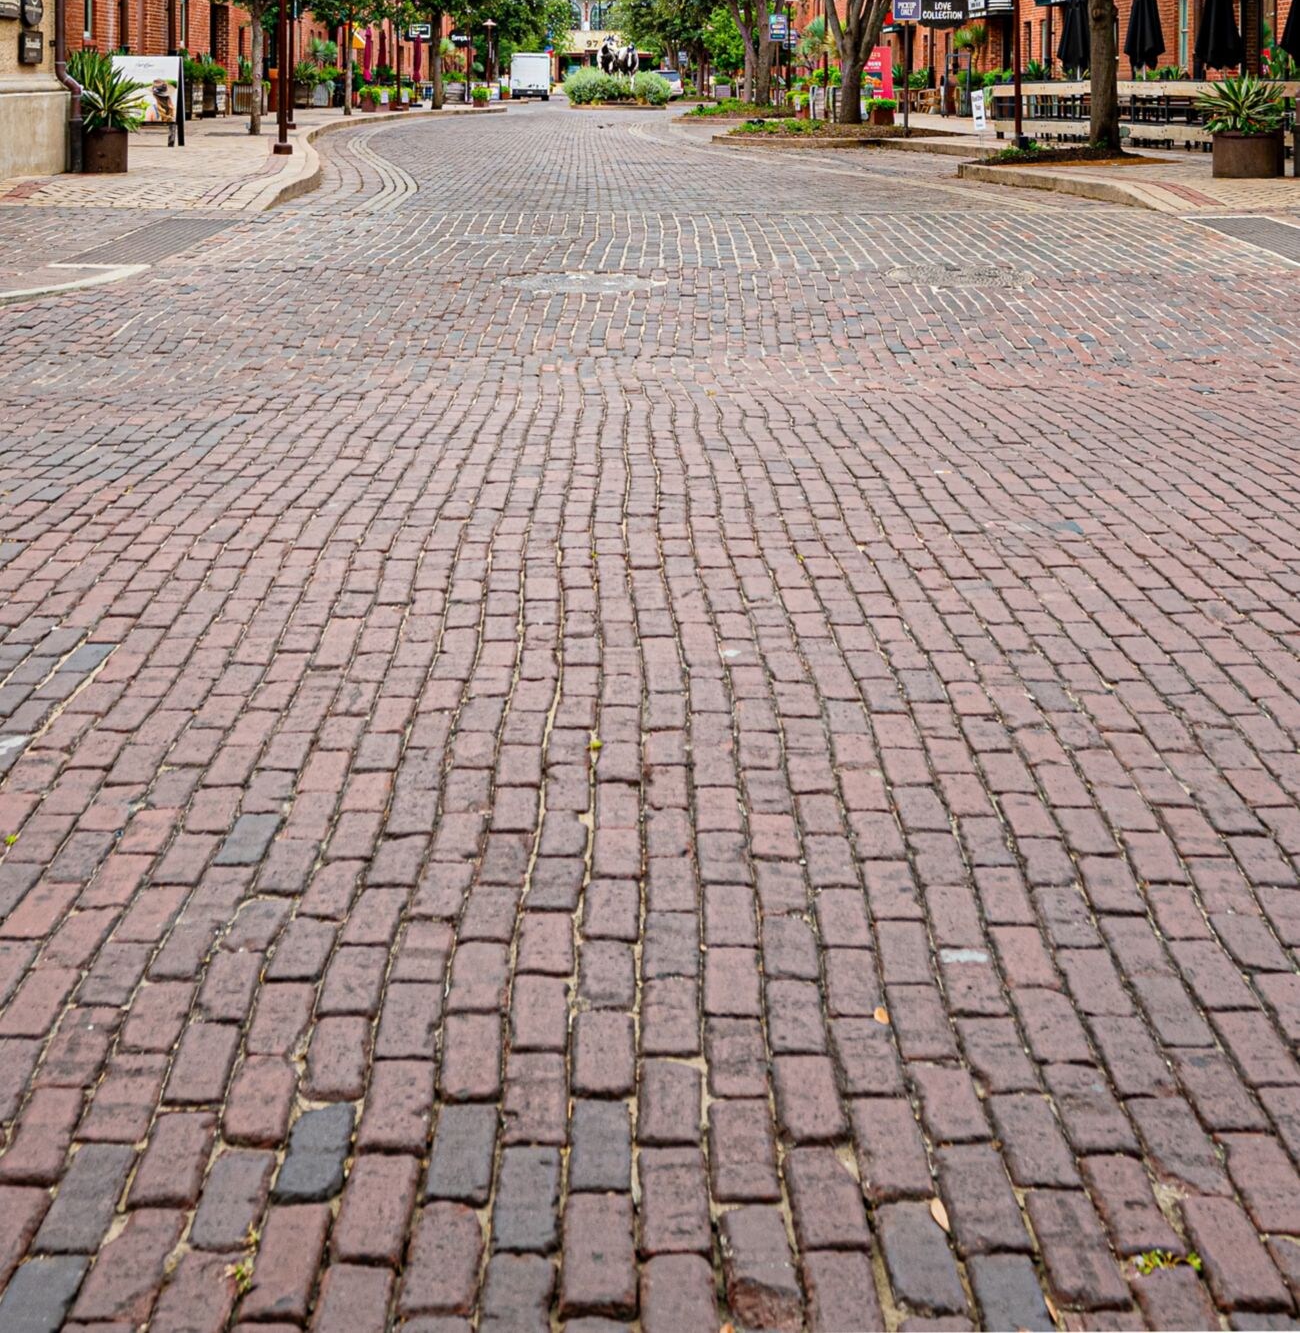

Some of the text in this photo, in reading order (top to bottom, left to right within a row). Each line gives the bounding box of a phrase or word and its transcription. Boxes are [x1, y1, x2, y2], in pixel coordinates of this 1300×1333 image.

[934, 1, 952, 10] LOVE
[922, 10, 963, 19] COLLECTION
[586, 40, 599, 48] 97
